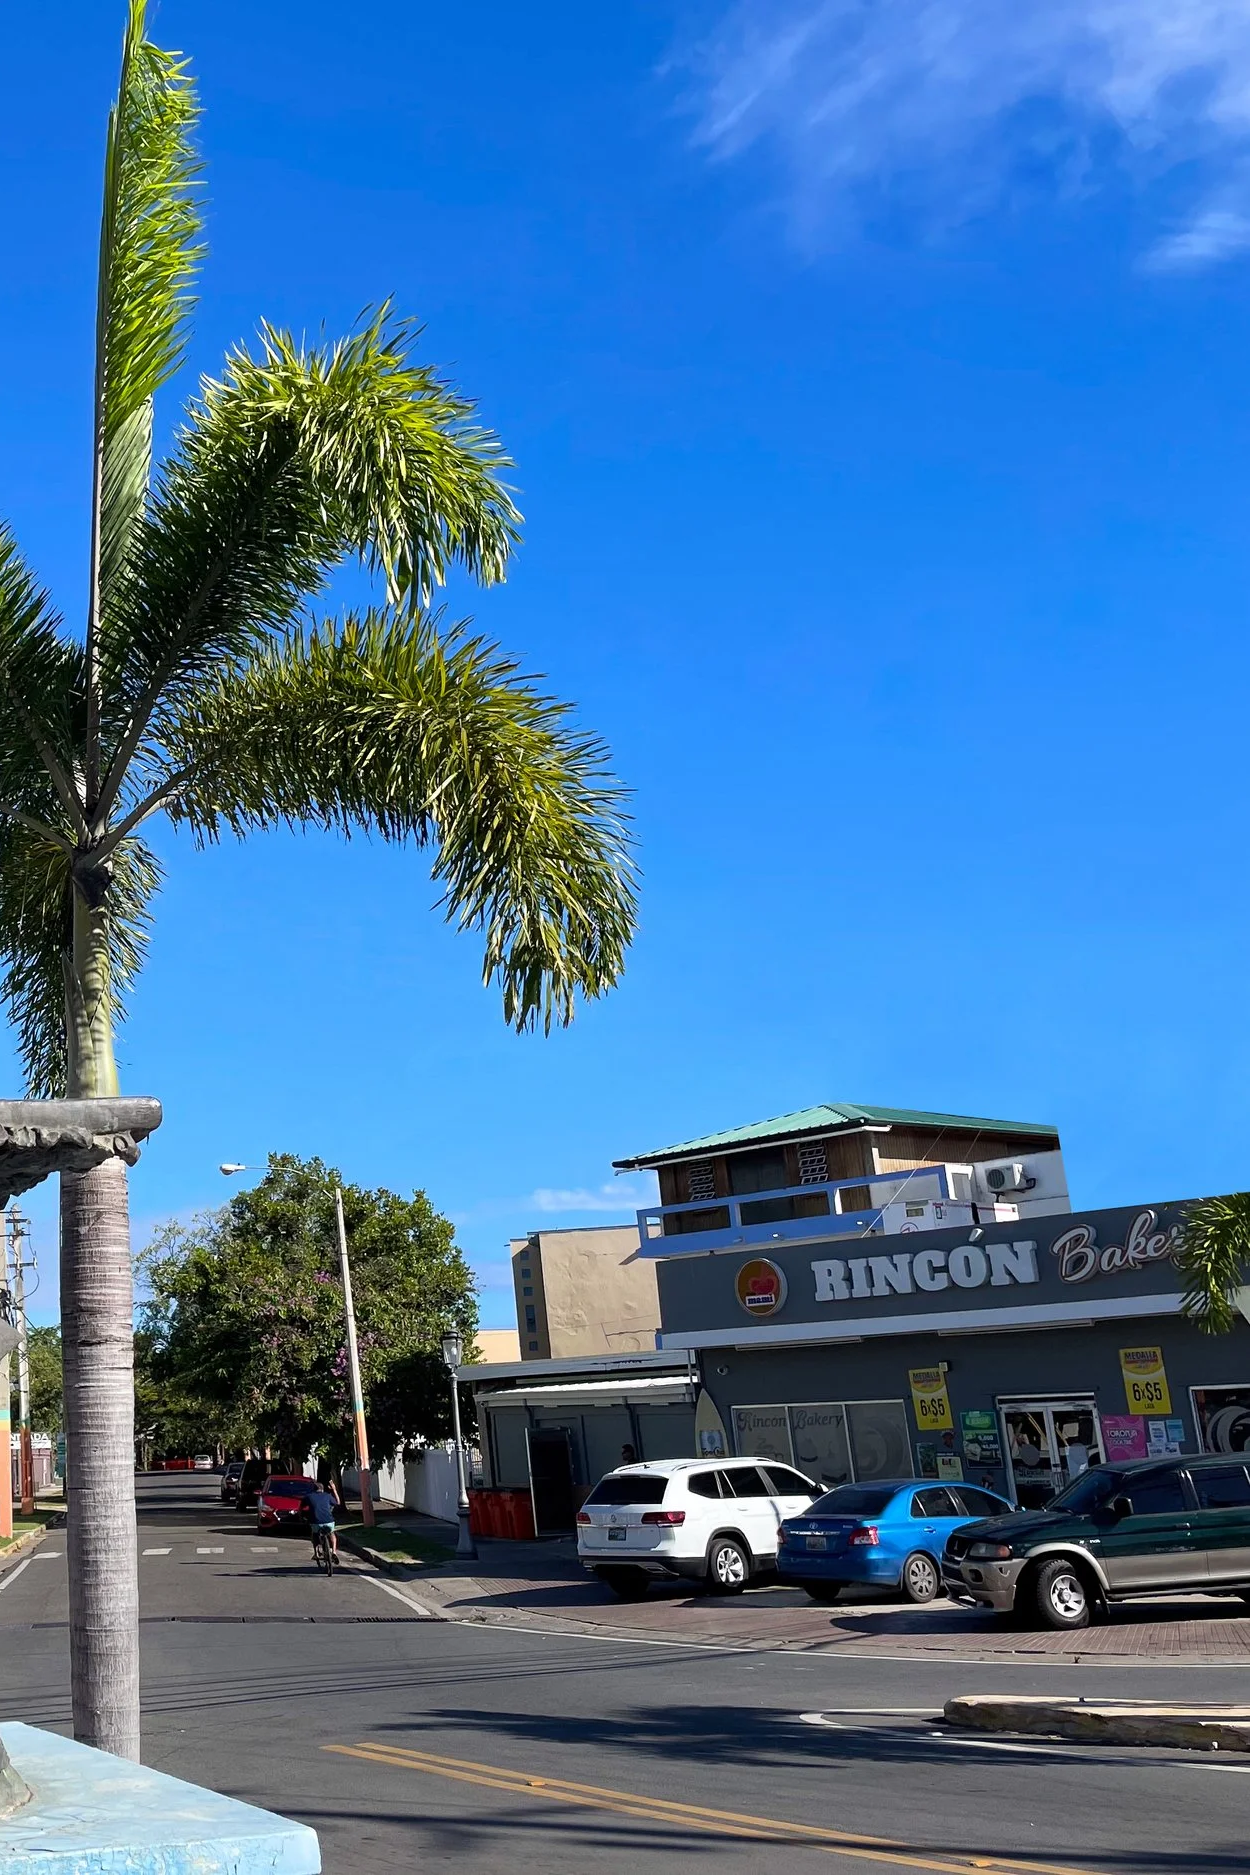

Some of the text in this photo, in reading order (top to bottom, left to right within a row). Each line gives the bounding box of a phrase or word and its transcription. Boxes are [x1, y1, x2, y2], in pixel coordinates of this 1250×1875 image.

[810, 1208, 1202, 1302] RINCÓN Bake
[1132, 1382, 1163, 1402] 6x$5
[919, 1398, 945, 1417] 6x$5
[794, 1409, 845, 1430] Bakery
